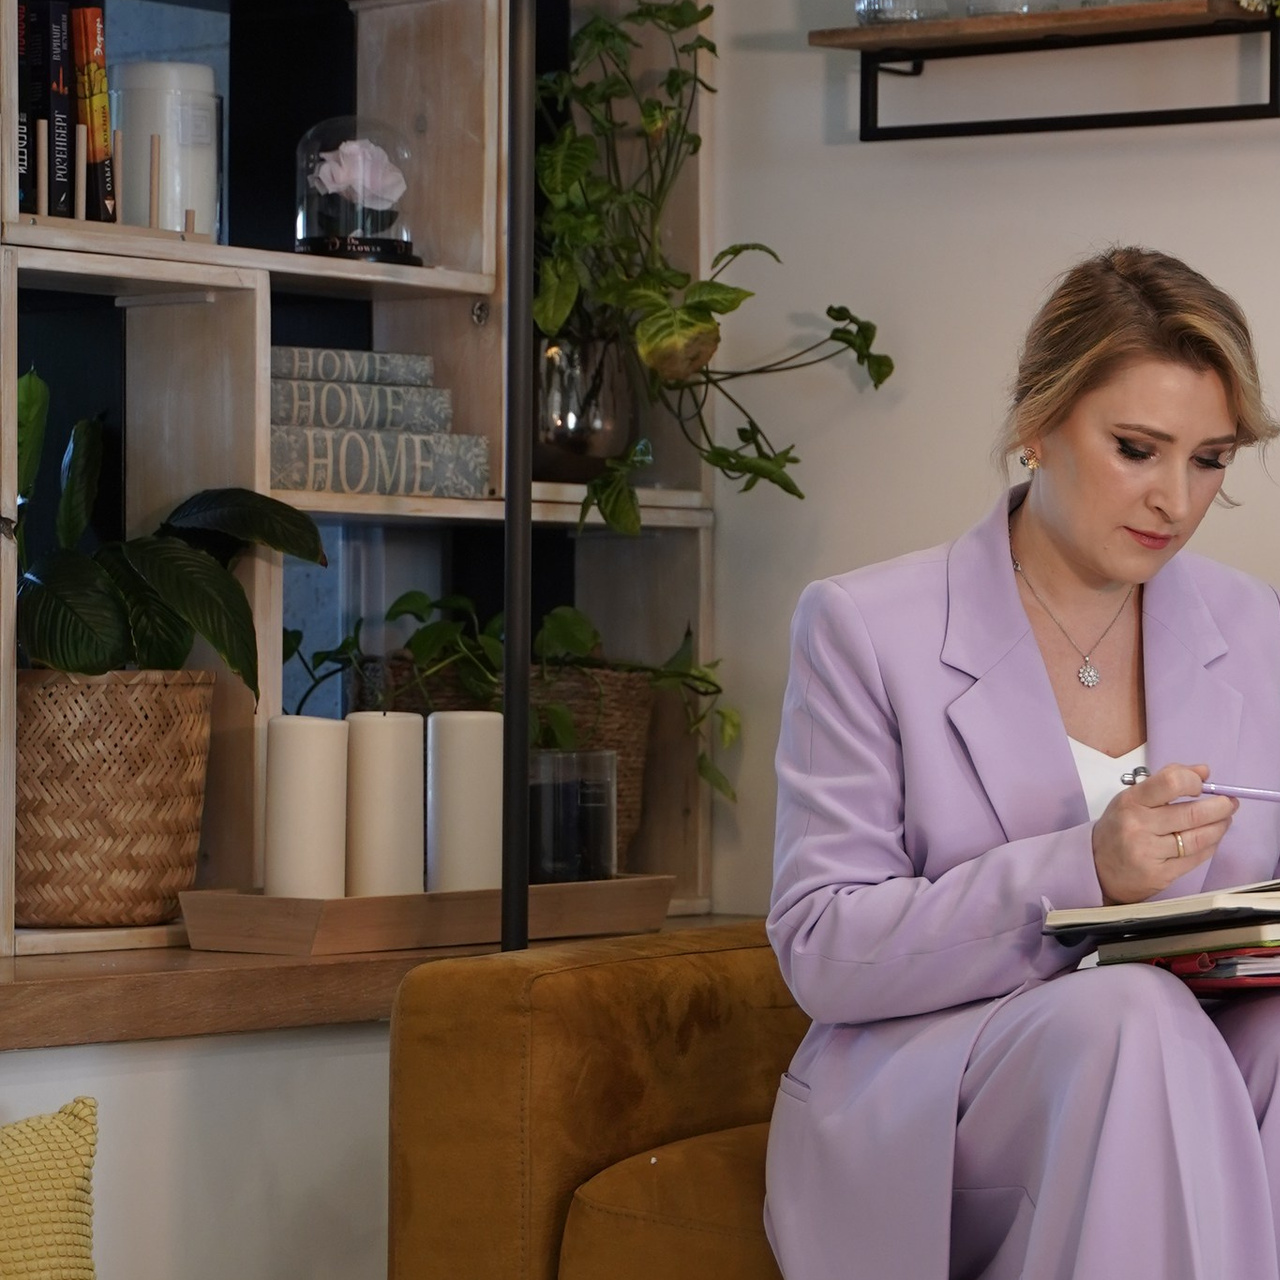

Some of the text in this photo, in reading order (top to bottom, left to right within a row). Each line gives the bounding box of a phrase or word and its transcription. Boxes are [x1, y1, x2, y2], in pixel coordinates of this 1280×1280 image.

[52, 24, 61, 61] ВАРИАНТ
[55, 110, 68, 182] РОЗЕНБЕРГ
[292, 349, 390, 382] HOME
[291, 380, 403, 430] HOME
[304, 429, 437, 497] HOME
